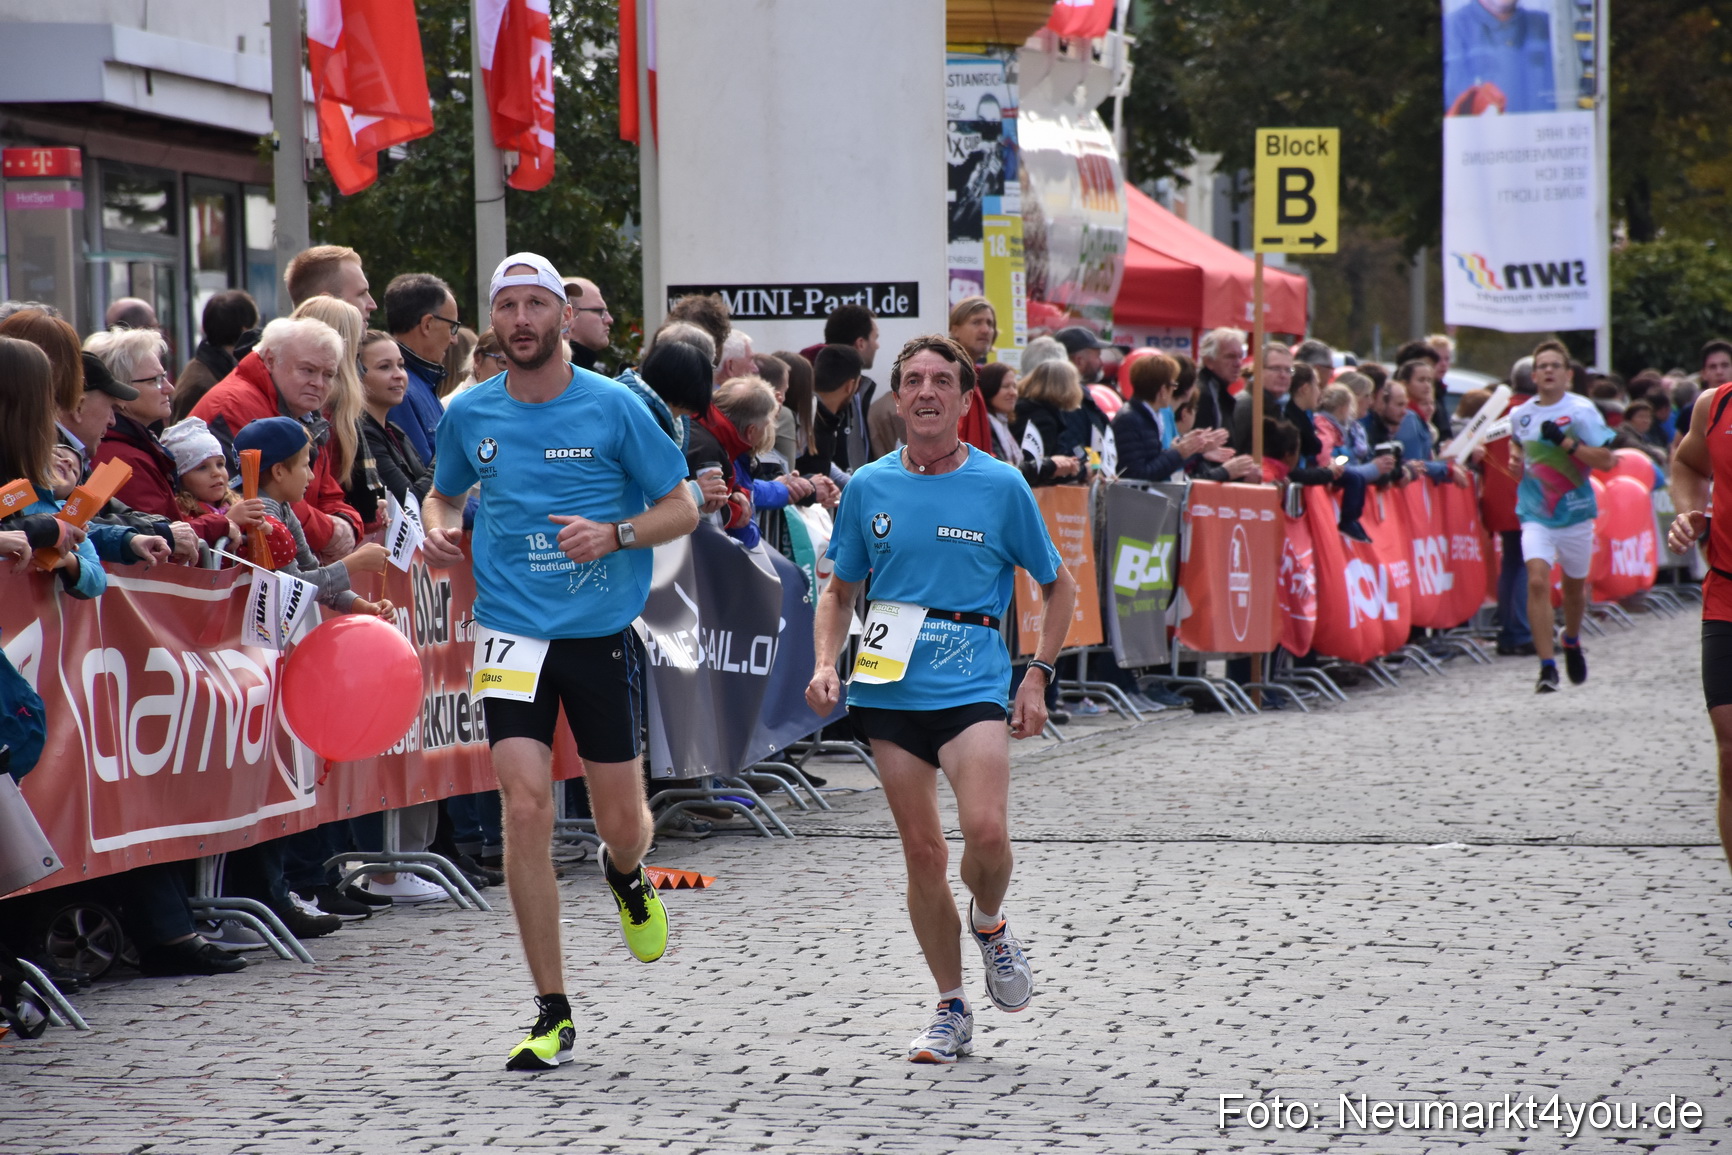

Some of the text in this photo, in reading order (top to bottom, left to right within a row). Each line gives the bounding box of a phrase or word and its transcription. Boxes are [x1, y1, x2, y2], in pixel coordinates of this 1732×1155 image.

[1266, 135, 1328, 156] Block
[1277, 168, 1317, 225] B
[545, 448, 592, 459] BOCK
[525, 533, 553, 550] 18.
[938, 527, 984, 542] BOCK
[528, 551, 566, 561] Neumar
[530, 560, 576, 572] Stadtlauf
[256, 581, 268, 624] swn
[286, 578, 304, 621] swn
[864, 622, 889, 650] 42
[484, 637, 516, 663] 17
[938, 648, 962, 666] September
[959, 641, 971, 650] 2017
[482, 673, 503, 683] Claus
